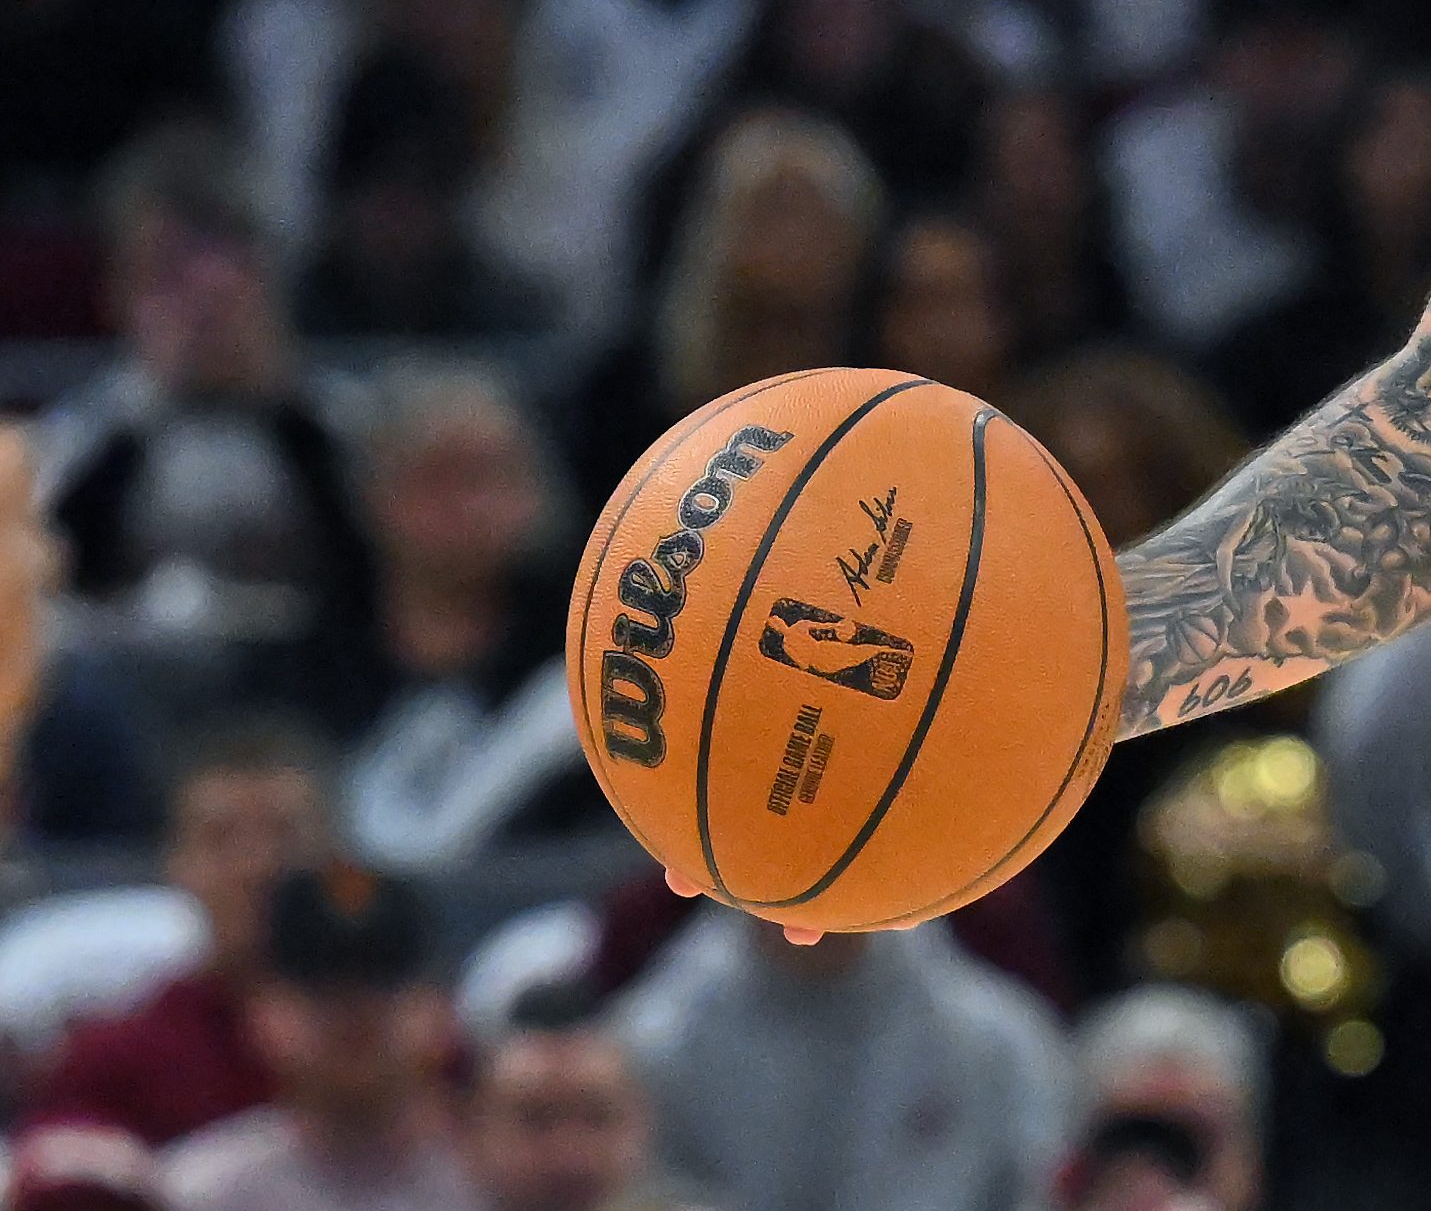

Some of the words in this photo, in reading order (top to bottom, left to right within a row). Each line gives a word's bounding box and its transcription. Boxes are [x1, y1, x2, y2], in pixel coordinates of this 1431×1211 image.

[602, 425, 795, 768] Wilson
[793, 703, 823, 736] BALL
[781, 732, 812, 771] GAME
[766, 767, 800, 817] OFFICIAL
